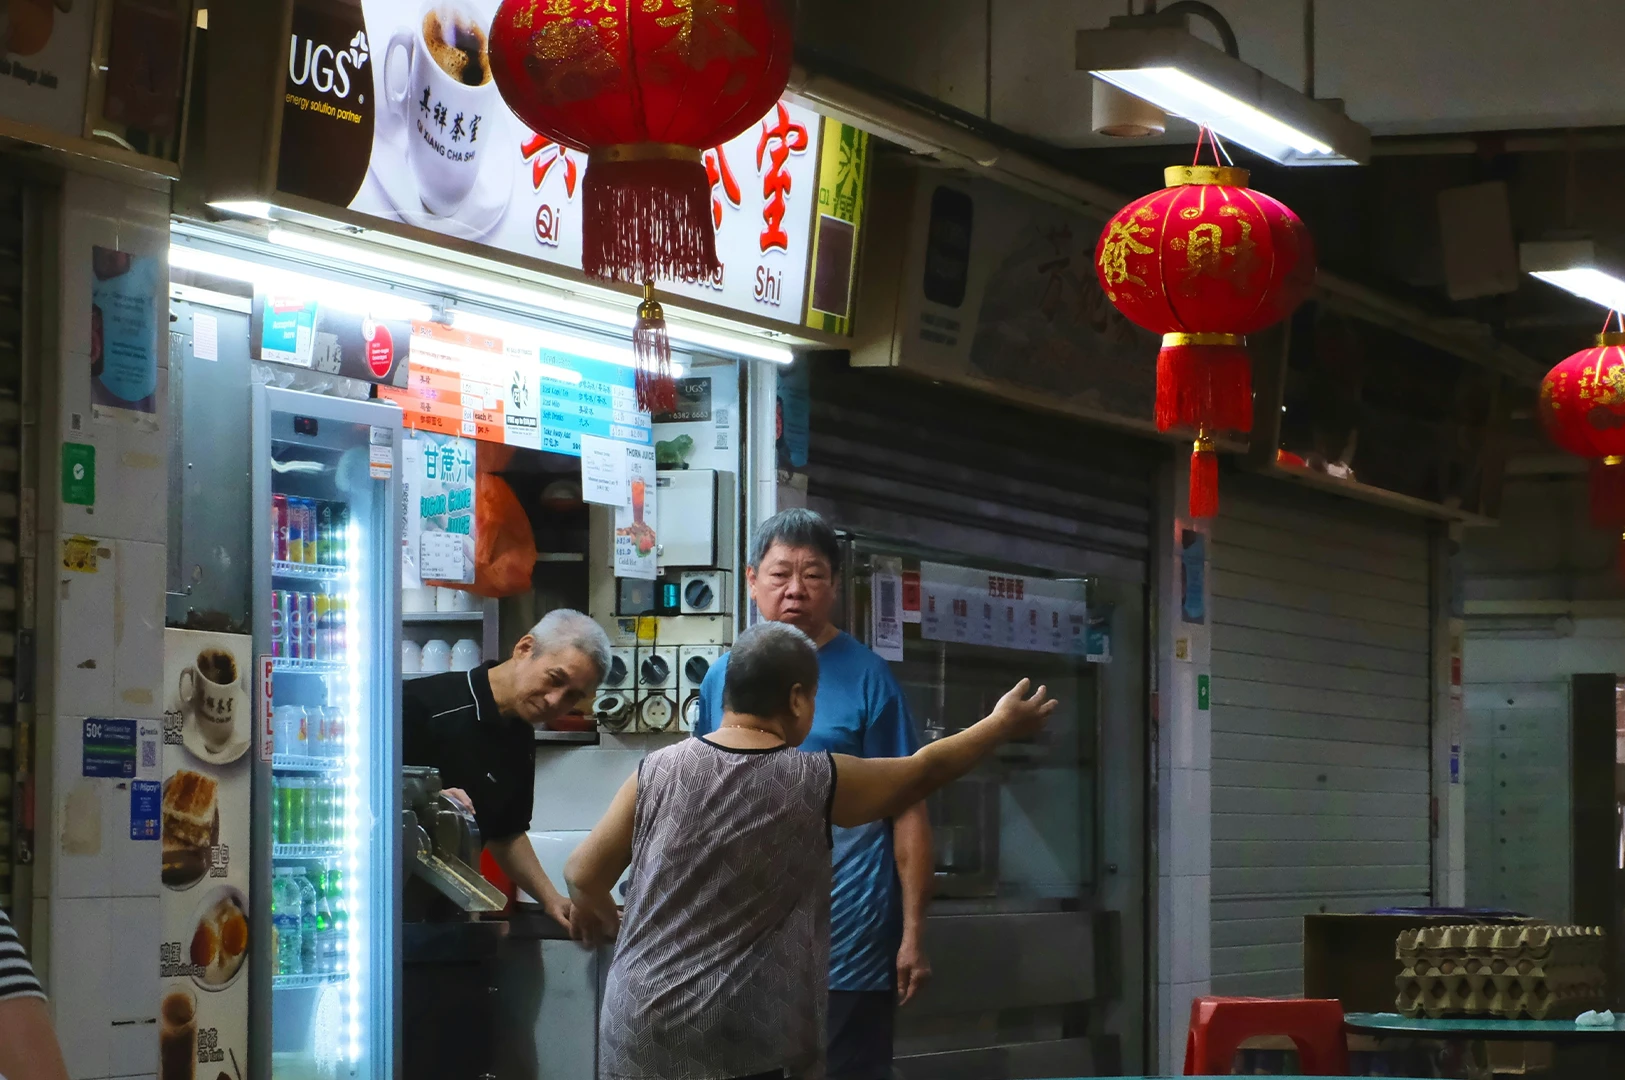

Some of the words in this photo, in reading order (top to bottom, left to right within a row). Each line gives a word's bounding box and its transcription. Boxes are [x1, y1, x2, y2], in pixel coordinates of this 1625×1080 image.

[289, 34, 352, 98] UGS
[285, 93, 309, 109] energy
[310, 100, 336, 116] solution
[336, 109, 362, 123] partner
[423, 128, 446, 156] XIANG
[447, 149, 463, 161] CHA
[535, 203, 560, 242] Qi
[754, 265, 782, 302] Shi
[685, 384, 704, 393] UGS
[673, 411, 690, 419] 6382
[424, 443, 472, 484] 甘蔗汁
[641, 450, 655, 461] JUICE
[447, 487, 472, 511] CANE
[265, 661, 273, 736] PULL
[86, 723, 102, 739] 50¢
[163, 732, 183, 746] Coffee
[210, 866, 228, 878] Bread
[192, 963, 206, 978] Egg
